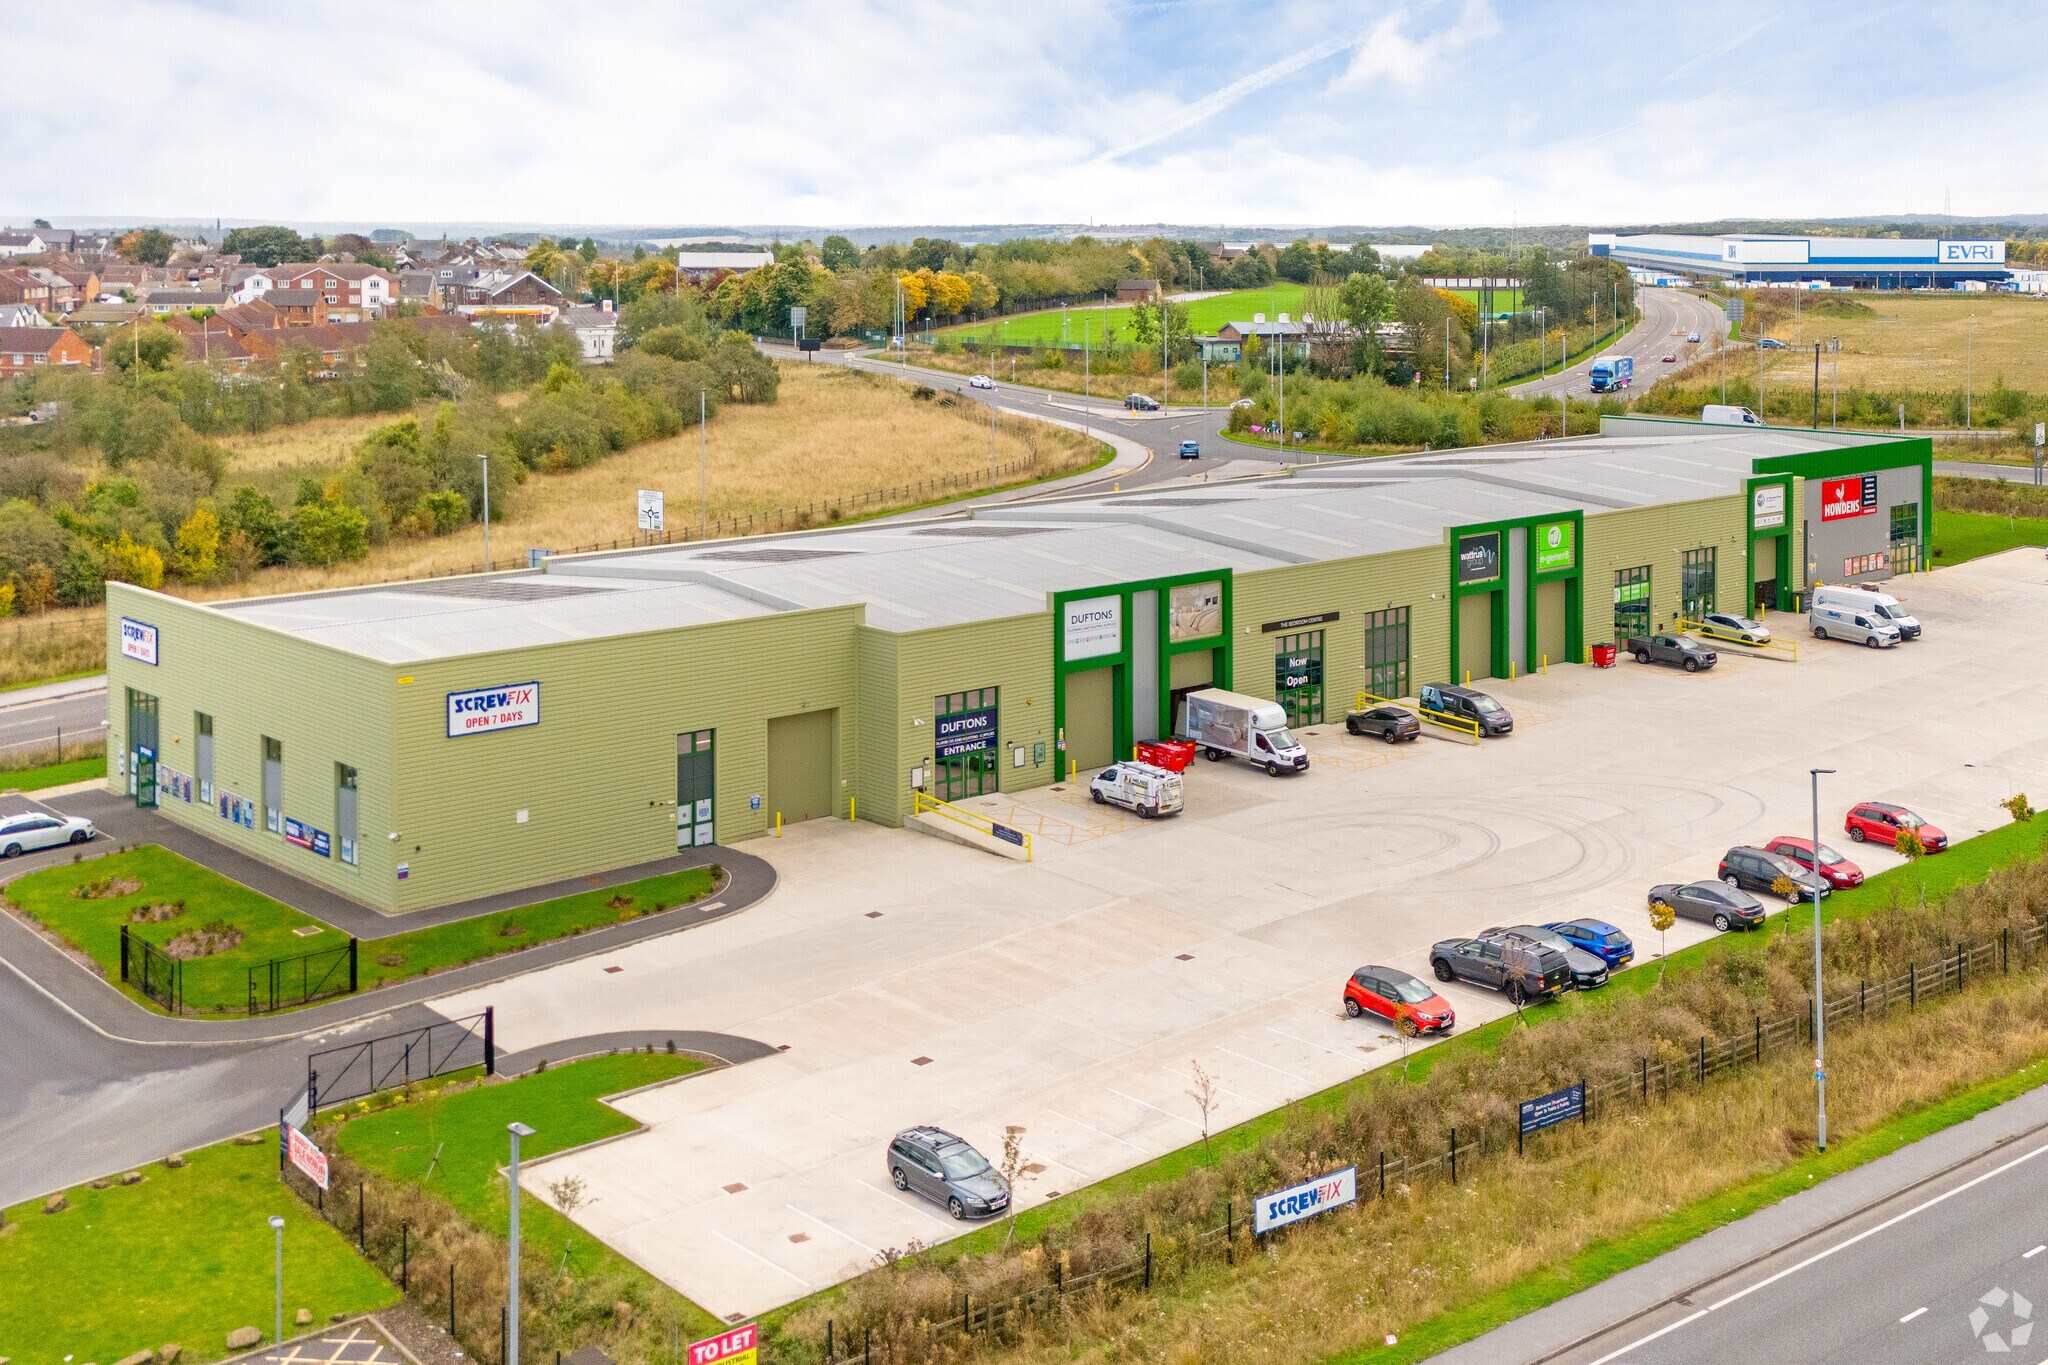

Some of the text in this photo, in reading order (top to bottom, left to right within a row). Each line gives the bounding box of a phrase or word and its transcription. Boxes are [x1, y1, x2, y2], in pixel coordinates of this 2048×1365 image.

[1947, 245, 1994, 260] EVRi
[1824, 499, 1860, 518] HOWDENS
[1460, 550, 1484, 561] wattrus
[1466, 558, 1484, 569] group
[1071, 609, 1113, 625] DUFTONS
[1289, 619, 1308, 627] BEDROOM
[1289, 656, 1308, 668] Now
[1286, 675, 1309, 688] Open
[454, 689, 533, 714] SCREWFIX
[466, 710, 523, 729] OPEN 7 DAYS
[941, 715, 988, 734] DUFTONS
[944, 740, 987, 756] ENTRANCE
[1269, 1179, 1343, 1221] SCREWFIX
[694, 1329, 753, 1363] TO LET
